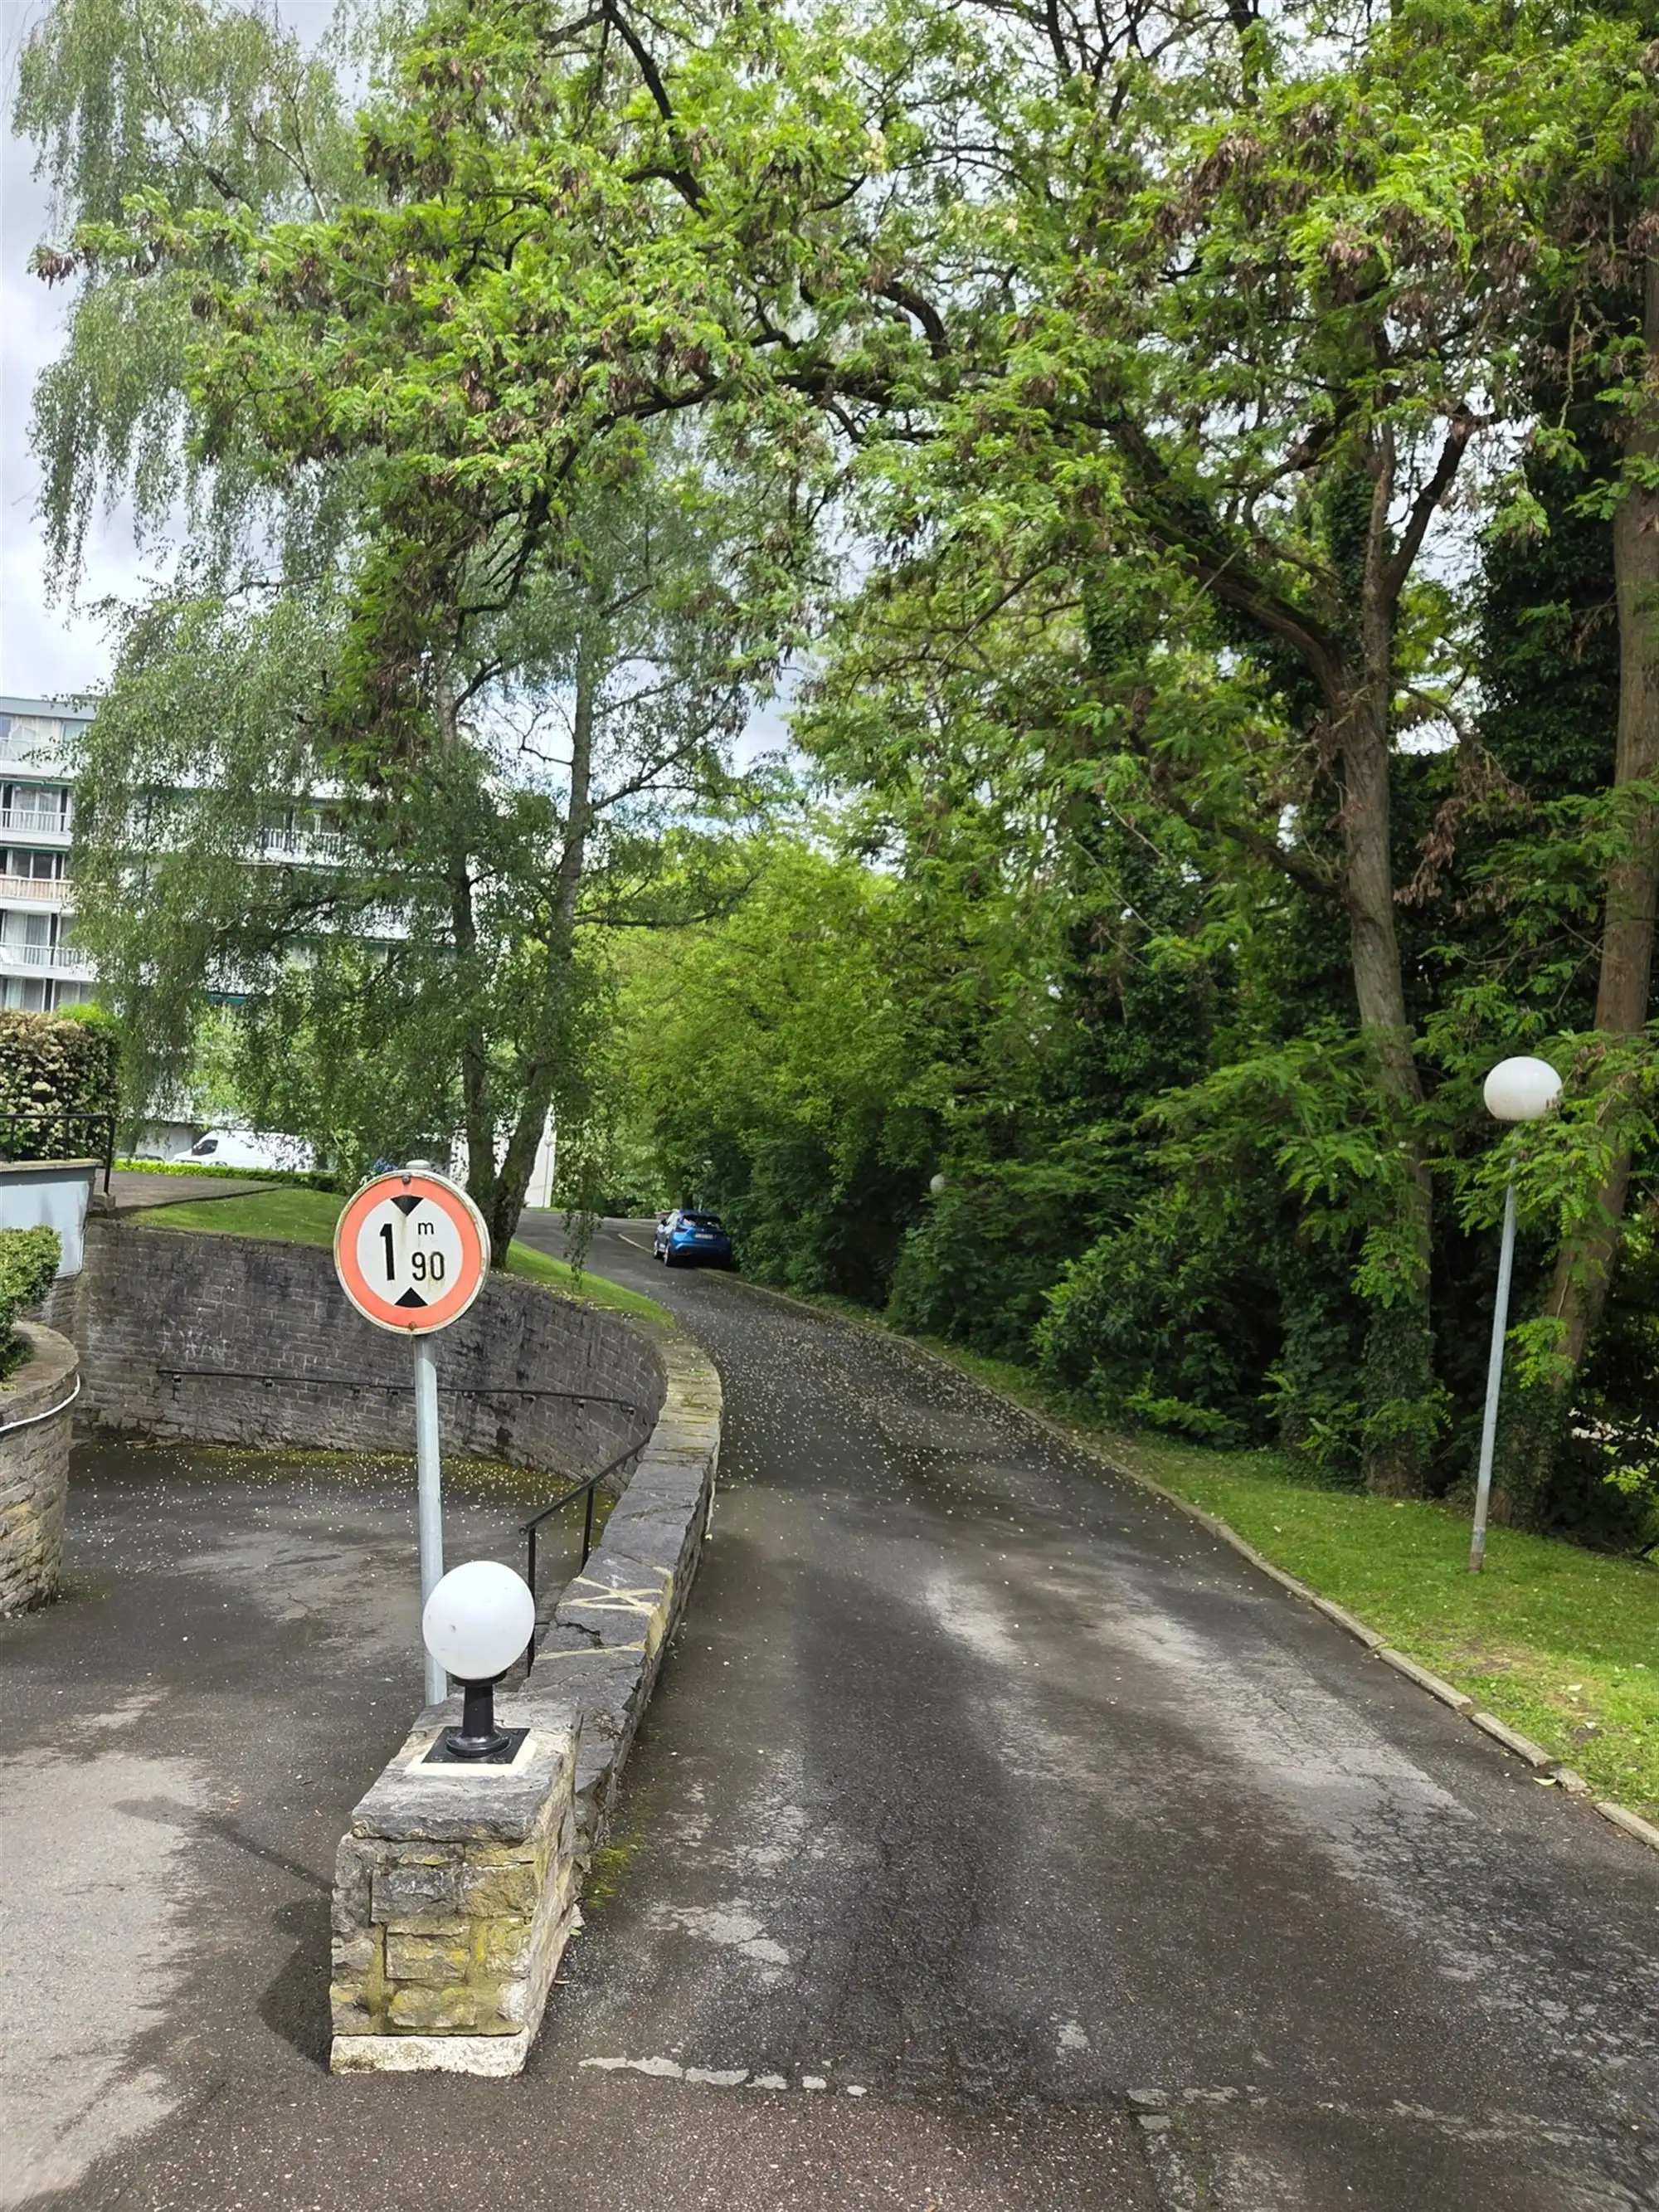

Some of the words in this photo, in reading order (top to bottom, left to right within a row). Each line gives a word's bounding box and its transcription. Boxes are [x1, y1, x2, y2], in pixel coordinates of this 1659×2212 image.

[417, 1222, 435, 1235] m
[379, 1223, 396, 1281] 1
[411, 1251, 445, 1281] 90
